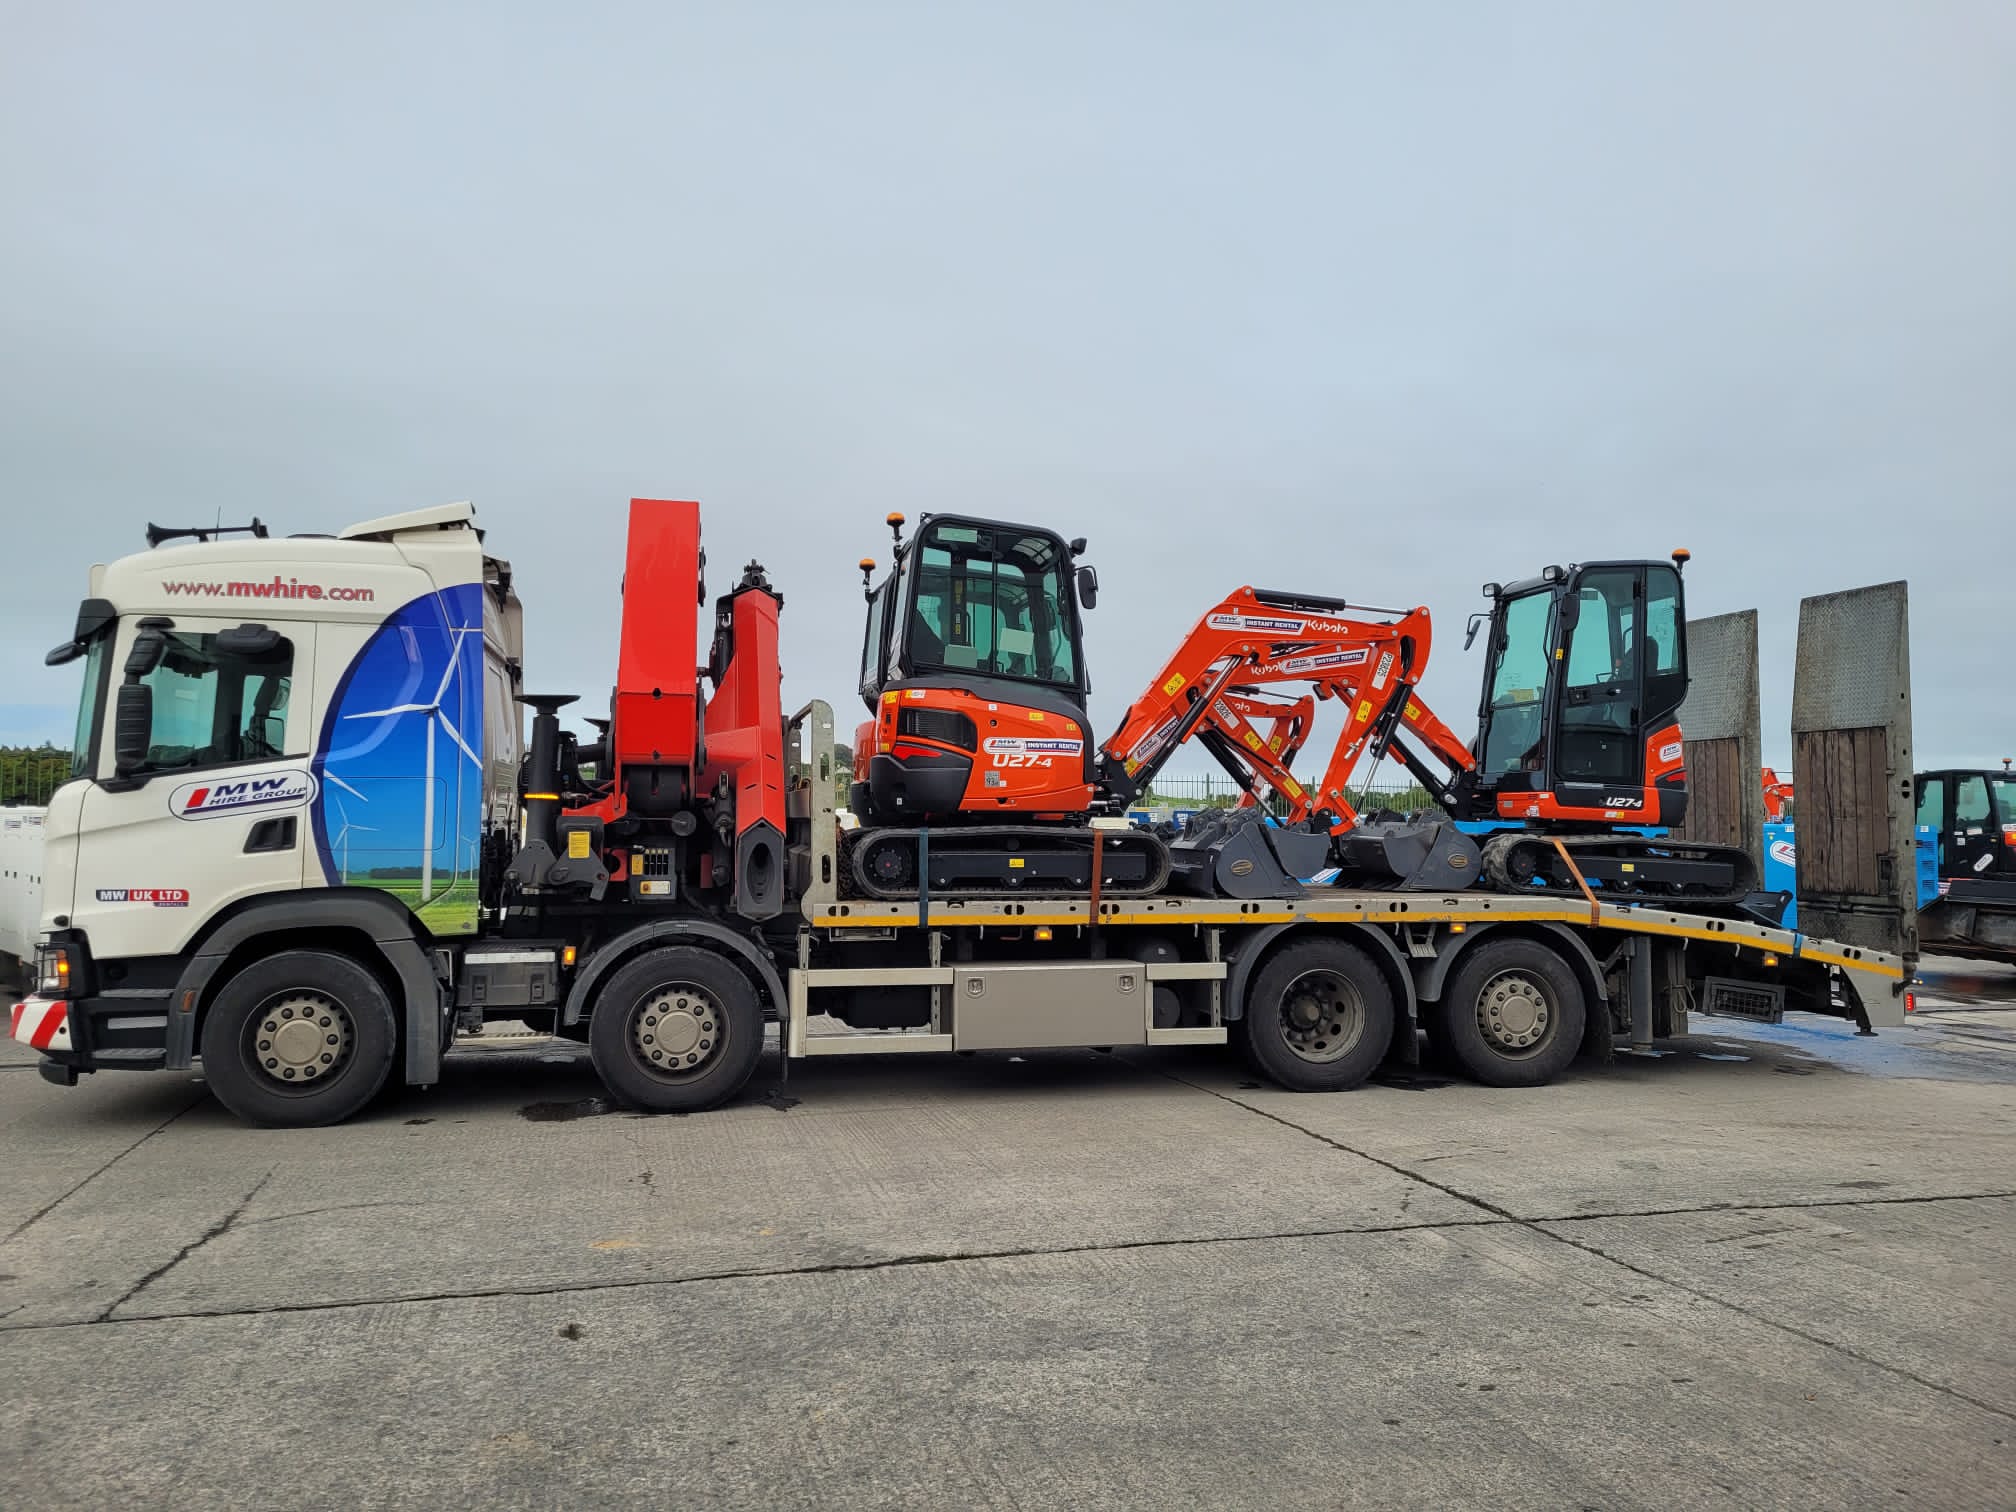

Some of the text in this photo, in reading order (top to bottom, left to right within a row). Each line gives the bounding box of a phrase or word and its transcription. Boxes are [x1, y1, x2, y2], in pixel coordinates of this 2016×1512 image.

[162, 576, 375, 601] www.mwhire.com
[1246, 619, 1299, 630] INSTANT RENTAL
[1307, 619, 1349, 634] Kubota
[1315, 652, 1363, 664] INSTANT RENTAL
[1250, 662, 1282, 676] Kubo
[1026, 742, 1057, 750] INSTANT
[992, 753, 1053, 768] U27-4
[214, 777, 289, 797] MW
[209, 786, 307, 806] HIRE GROUP
[1606, 797, 1643, 808] U27-4
[100, 890, 183, 901] MW UK LTD
